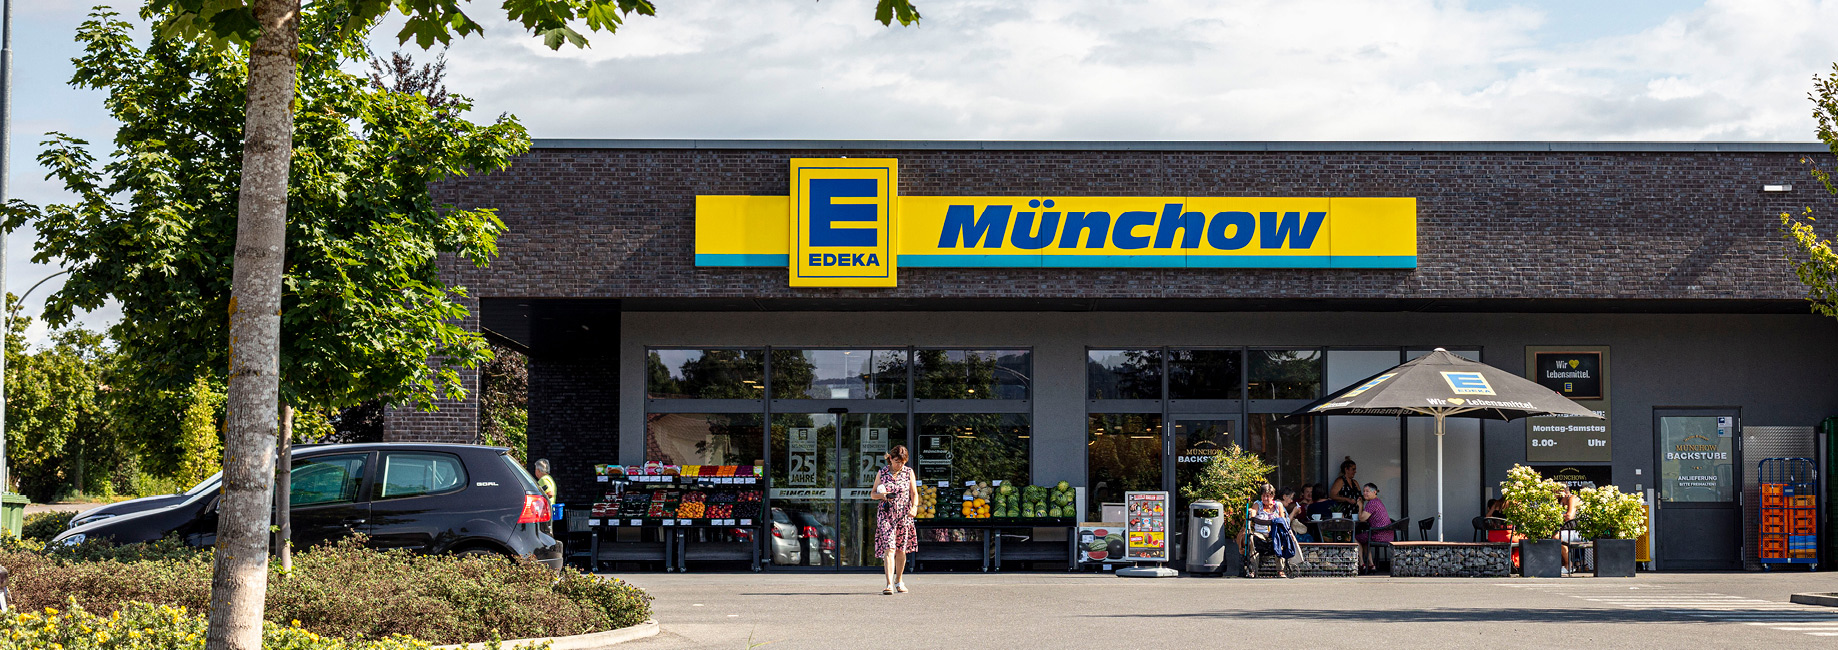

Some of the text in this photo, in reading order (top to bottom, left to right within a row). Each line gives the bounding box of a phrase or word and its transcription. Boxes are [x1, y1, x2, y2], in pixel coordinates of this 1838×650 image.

[809, 178, 878, 247] E
[937, 198, 1328, 251] Münchow
[808, 253, 880, 266] EDEKA
[1555, 360, 1568, 369] Wir
[1465, 398, 1537, 410] Lebensmittel.
[1532, 425, 1606, 433] Montag-Samstag
[1532, 439, 1607, 447] 8.00- Uhr
[1177, 455, 1213, 463] BACKS
[1667, 452, 1727, 460] BACKSTUBE
[790, 455, 815, 473] 25
[790, 473, 815, 483] JAHRE
